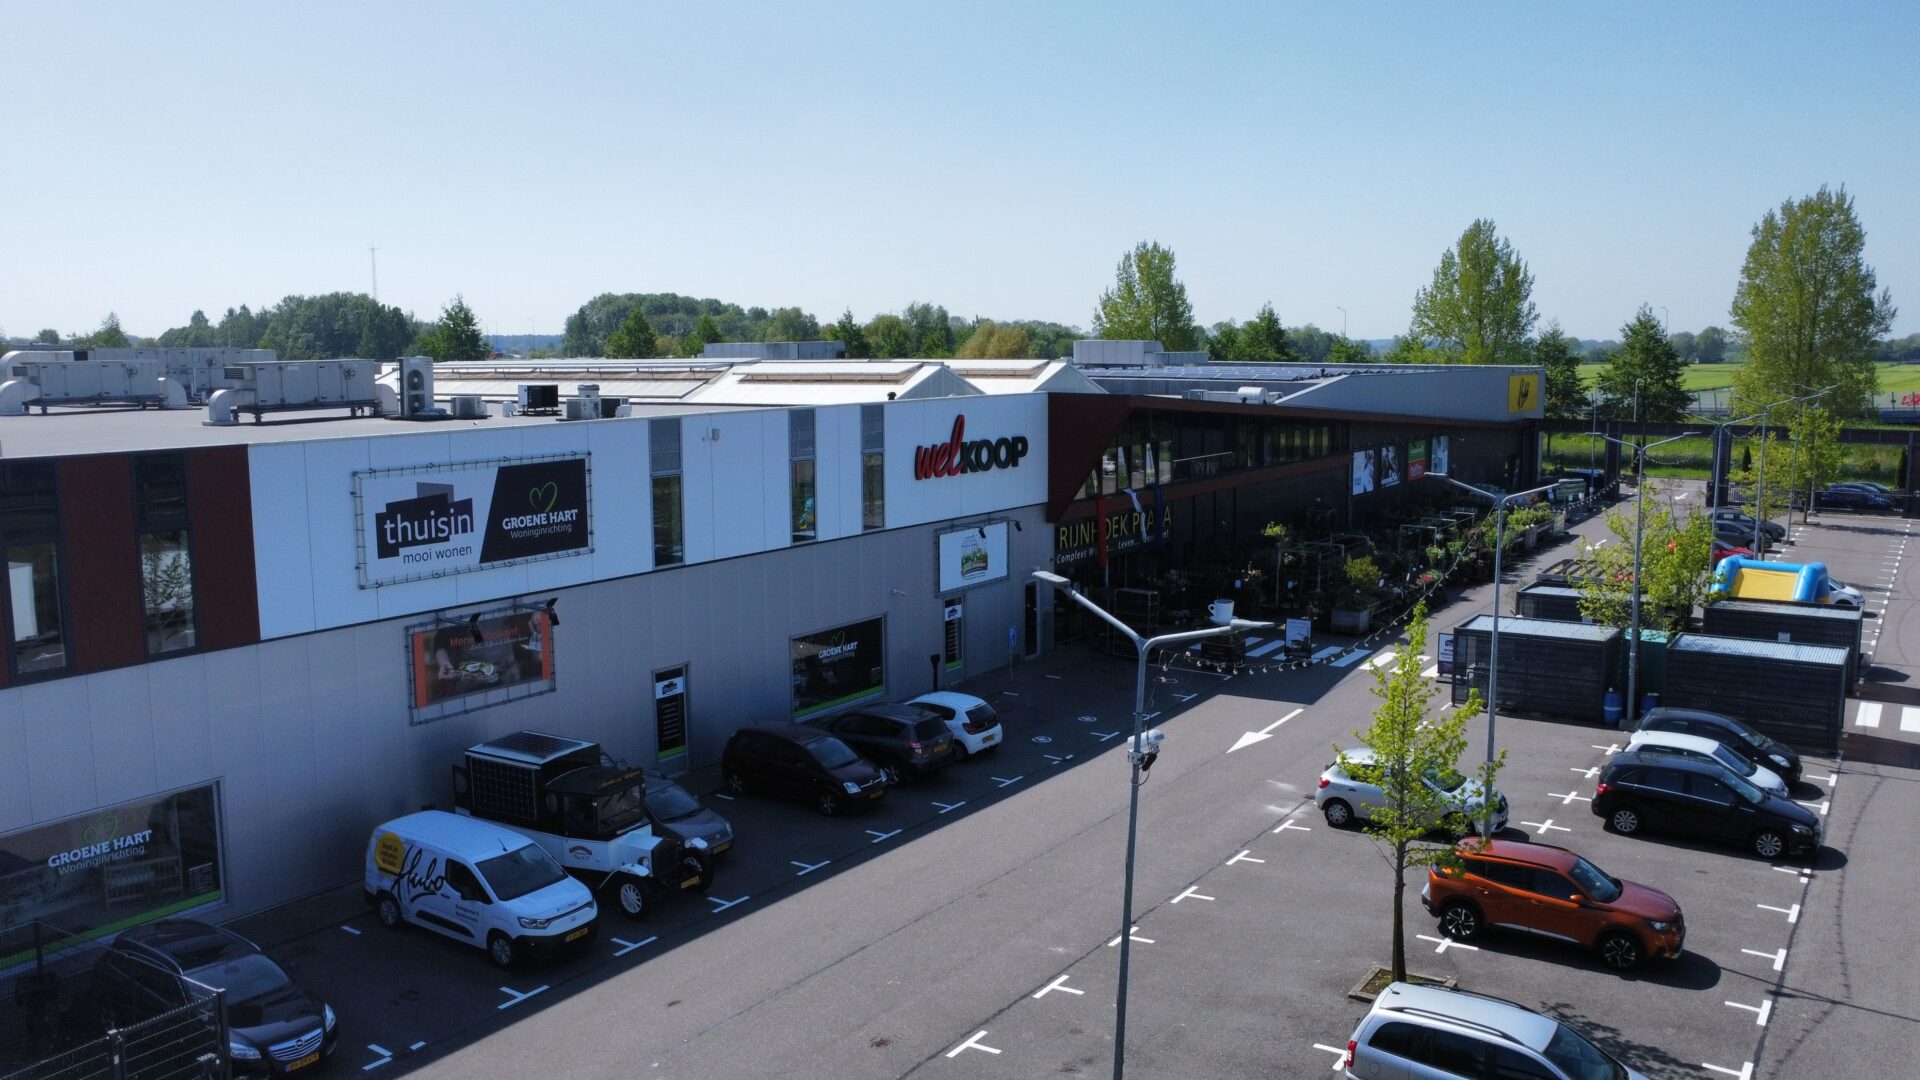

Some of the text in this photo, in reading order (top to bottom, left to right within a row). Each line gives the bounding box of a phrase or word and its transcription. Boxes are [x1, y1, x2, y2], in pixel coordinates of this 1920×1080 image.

[384, 508, 472, 544] thuisin
[502, 508, 578, 530] GROENE HART
[510, 523, 572, 540] Woninginrichting
[403, 545, 472, 564] mooi wonen
[818, 645, 842, 659] GROENE
[843, 641, 858, 653] HART
[47, 829, 153, 868] GROENE HART
[58, 844, 146, 876] Woninginrichting
